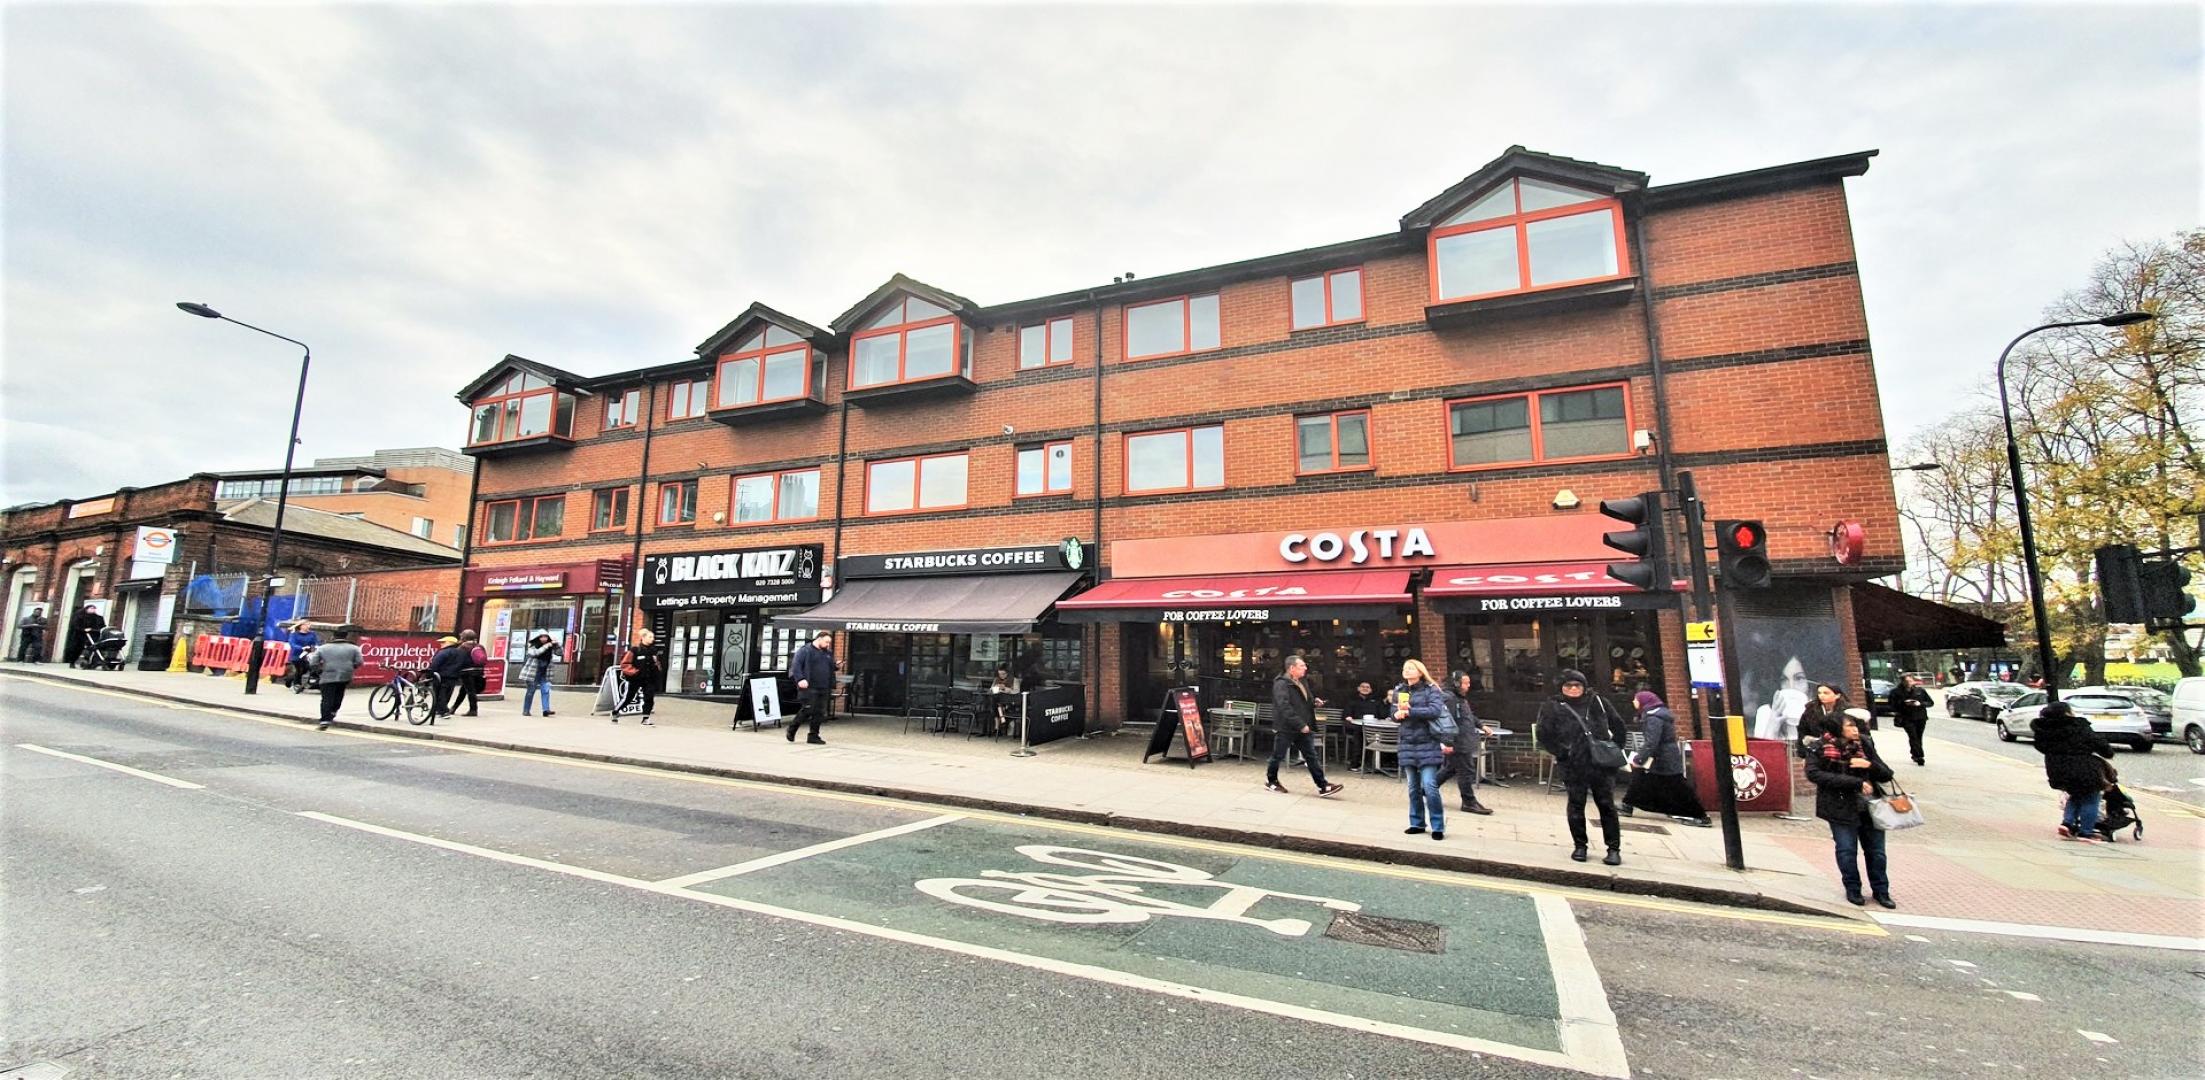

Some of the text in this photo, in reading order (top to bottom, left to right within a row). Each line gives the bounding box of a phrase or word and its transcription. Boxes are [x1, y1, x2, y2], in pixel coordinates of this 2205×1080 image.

[1279, 527, 1436, 564] COSTA
[671, 554, 741, 582] BLACK
[741, 550, 797, 579] KATZ
[884, 551, 1045, 570] STARBUCKS COFFEE
[1449, 571, 1614, 584] COST
[1161, 586, 1308, 598] COSTA
[656, 592, 798, 607] Lettings & Property Management
[1480, 596, 1622, 611] FOR COFFEE LOVERS
[1162, 609, 1269, 621] FOR COFFEE LOVERS
[846, 623, 939, 632] STARBUCKS COFFEE
[359, 643, 439, 661] Completely
[1045, 705, 1073, 716] STARBUCKS
[1051, 713, 1069, 723] COFFEE
